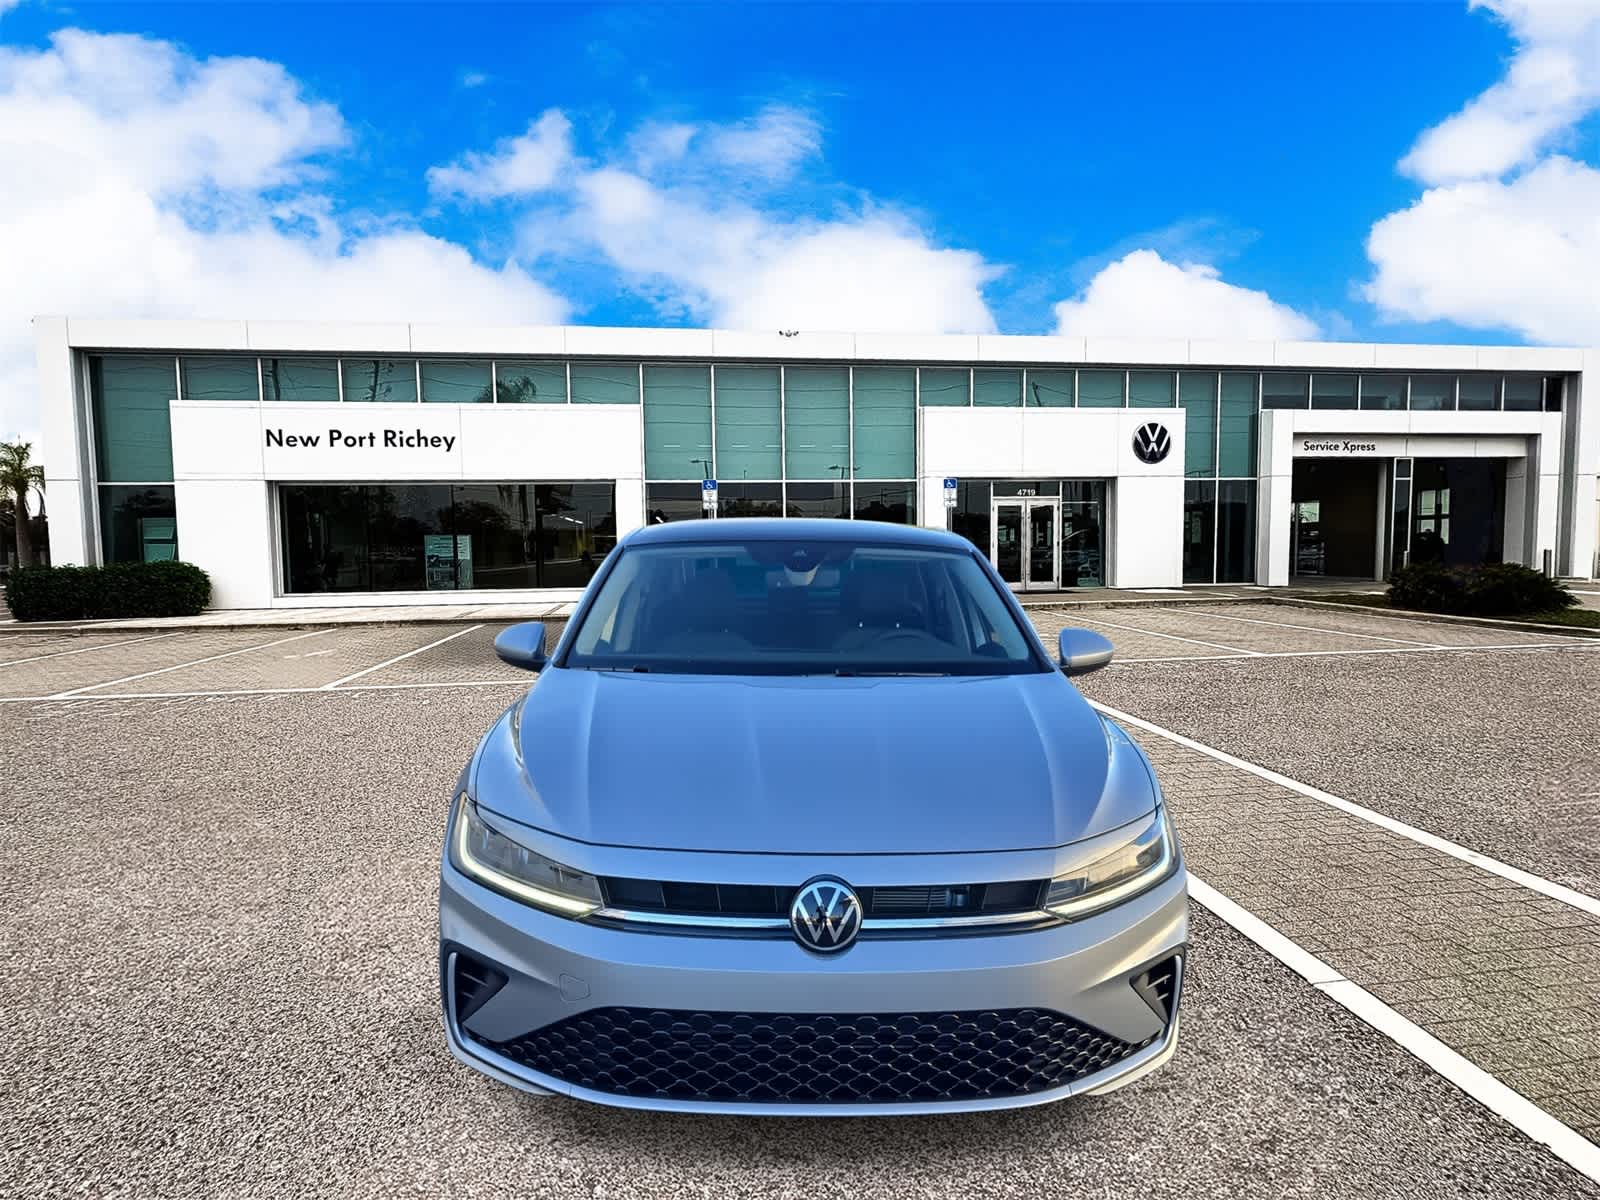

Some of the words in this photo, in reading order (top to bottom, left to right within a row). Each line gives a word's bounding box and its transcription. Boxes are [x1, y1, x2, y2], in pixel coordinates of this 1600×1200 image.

[265, 428, 321, 448] New
[328, 429, 377, 448] Port
[383, 428, 457, 453] Richey
[1133, 421, 1170, 462] VW
[1303, 440, 1340, 452] Service
[1342, 440, 1376, 454] Xpress
[1016, 488, 1036, 496] 4719
[793, 881, 861, 948] VW
